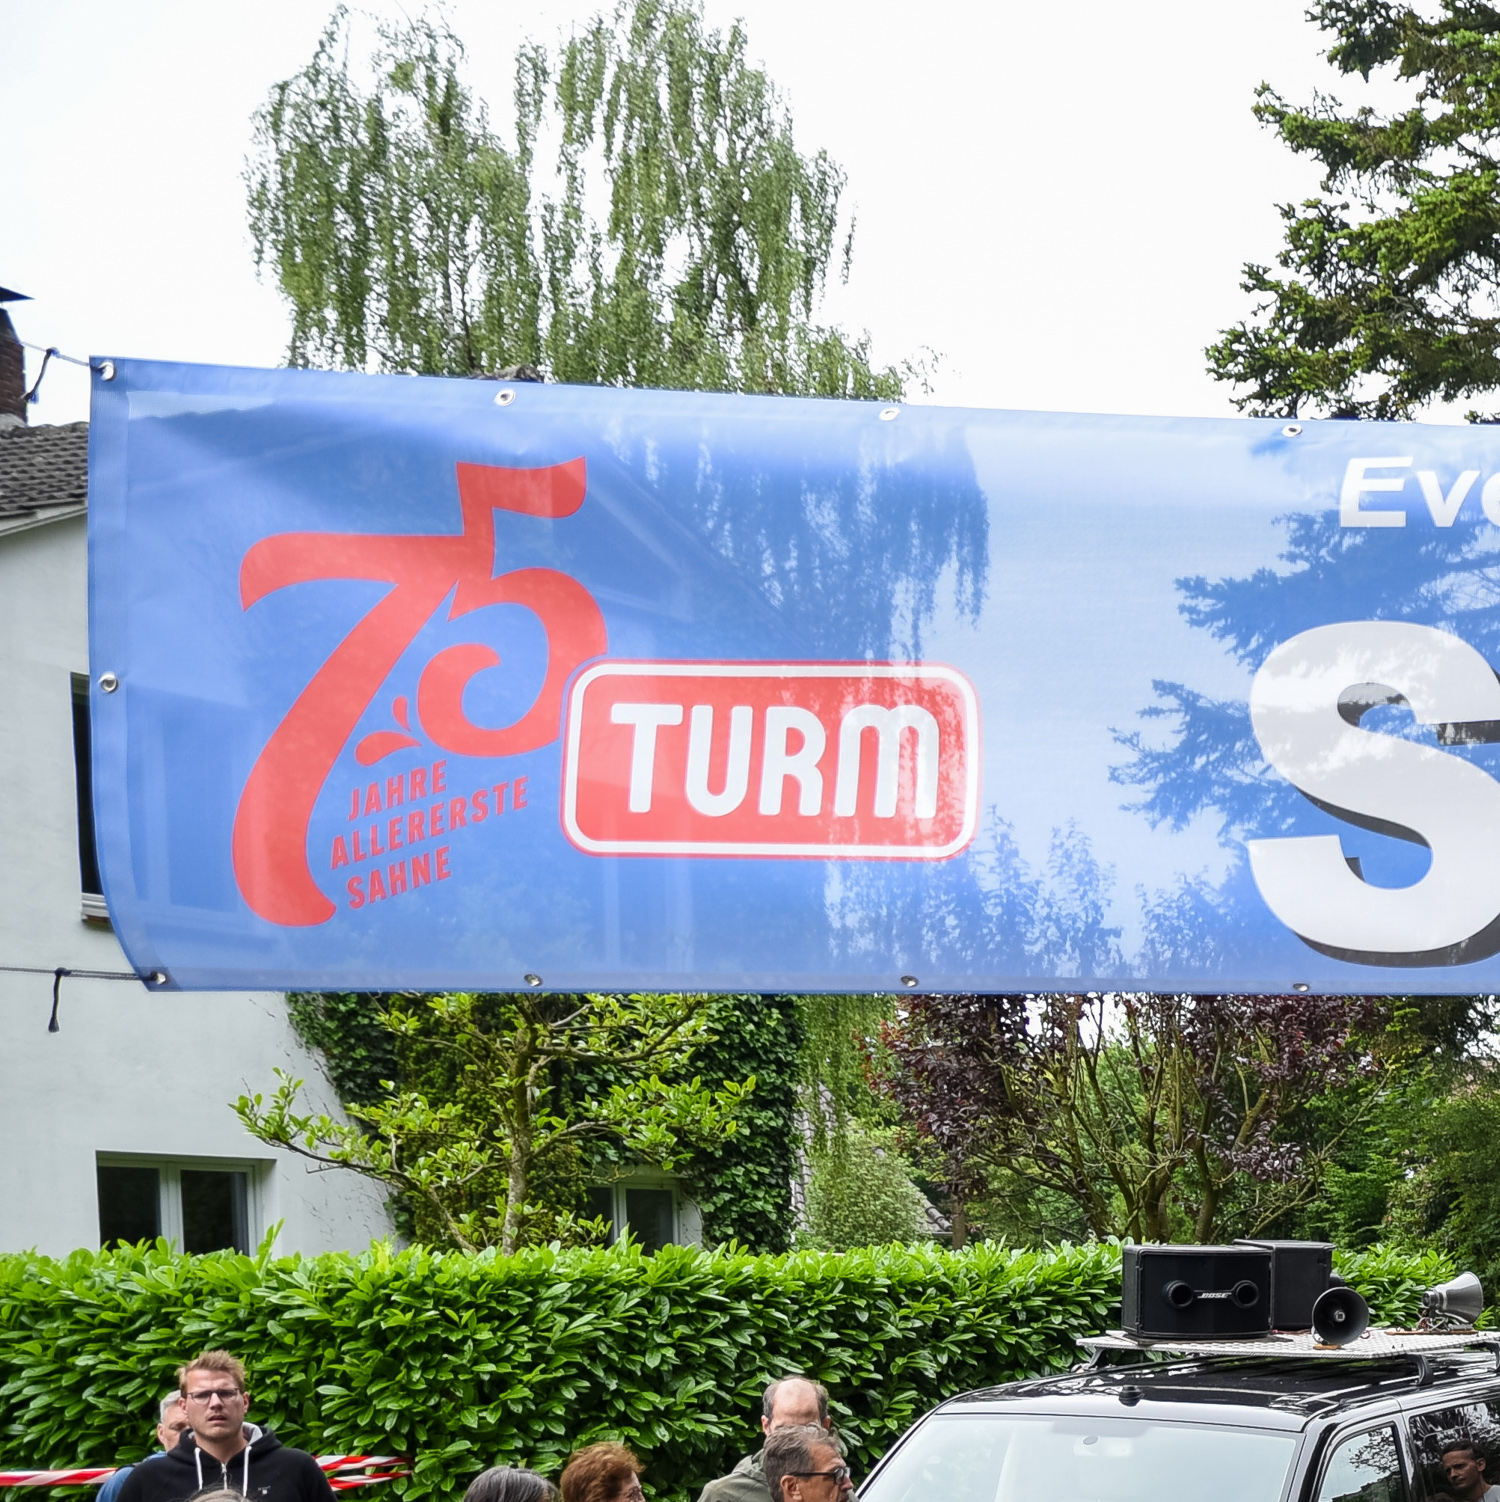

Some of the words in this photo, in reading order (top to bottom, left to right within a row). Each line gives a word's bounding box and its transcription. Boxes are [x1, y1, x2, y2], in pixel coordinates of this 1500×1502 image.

[348, 759, 447, 822] JAHRE
[610, 703, 940, 819] TURM
[330, 775, 529, 870] ALLERERSTE
[347, 846, 452, 910] SAHNE
